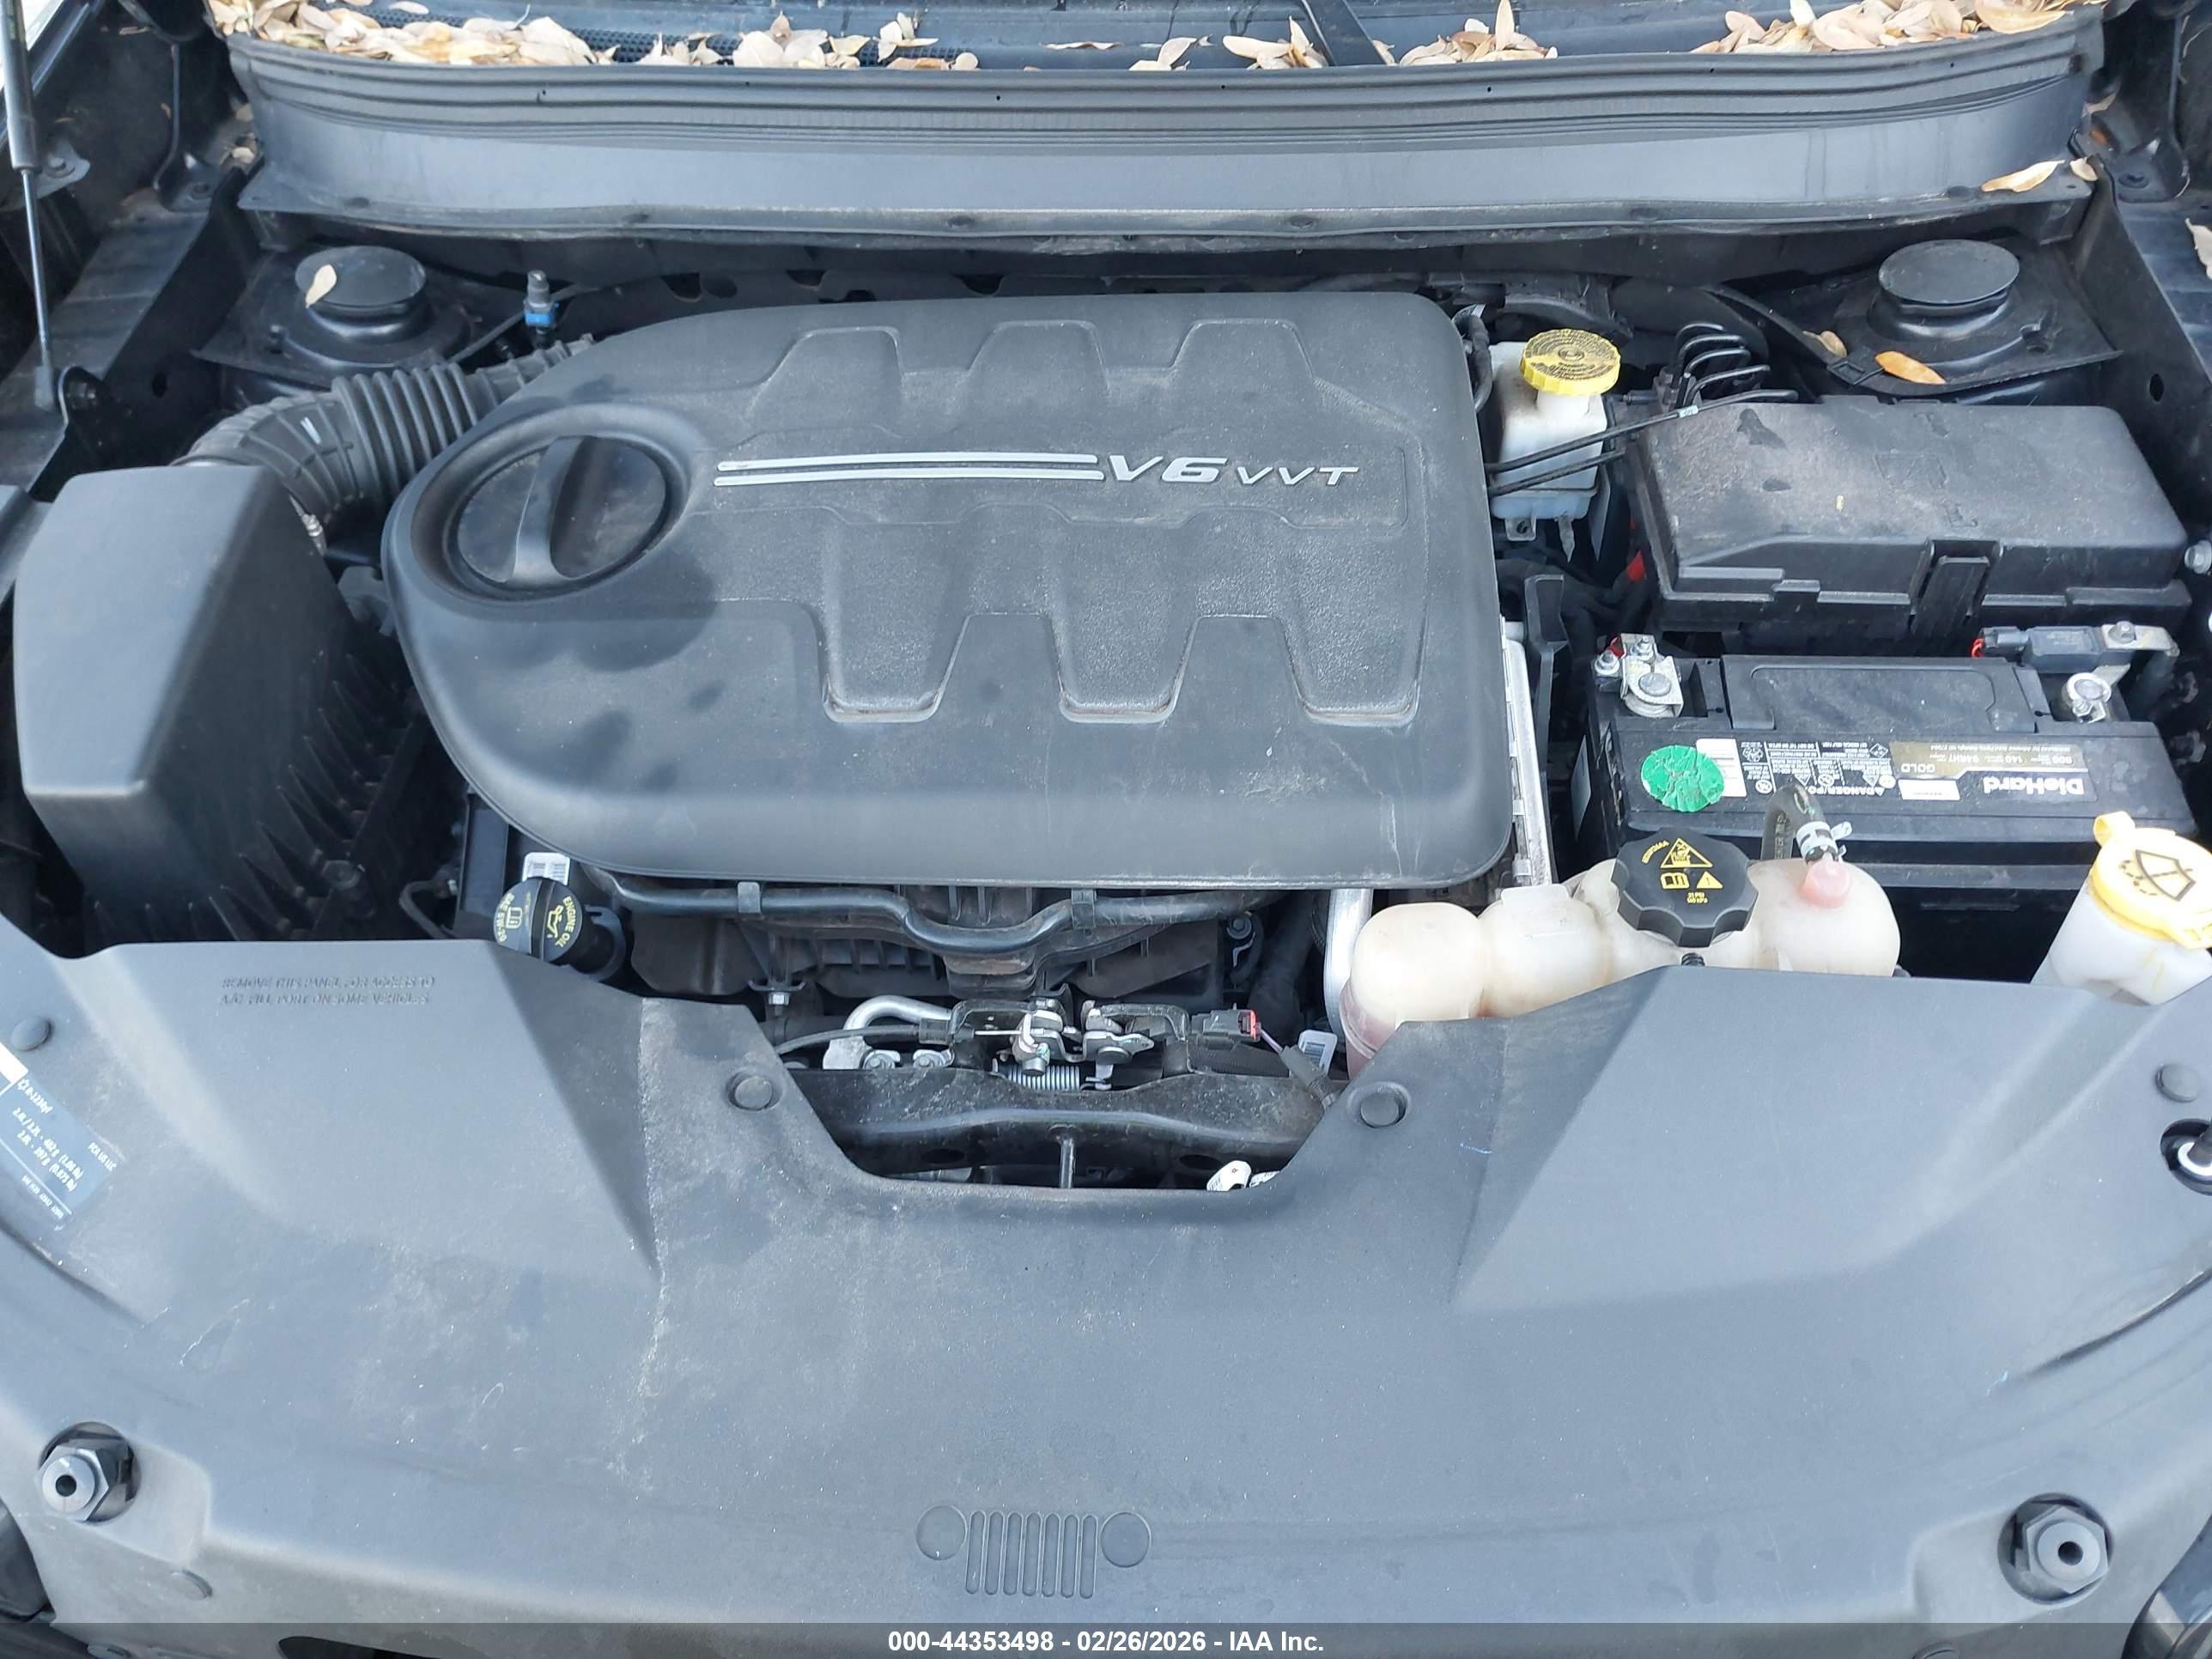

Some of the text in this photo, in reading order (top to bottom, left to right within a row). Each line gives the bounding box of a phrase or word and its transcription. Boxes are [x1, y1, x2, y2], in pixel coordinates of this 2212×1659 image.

[1109, 454, 1360, 486] V6 VVT
[2005, 755, 2023, 764] 140
[1900, 763, 1936, 774] GOLD
[1983, 775, 2085, 795] DieHard
[554, 896, 576, 948] ENGINE OIL
[313, 993, 331, 1006] ON
